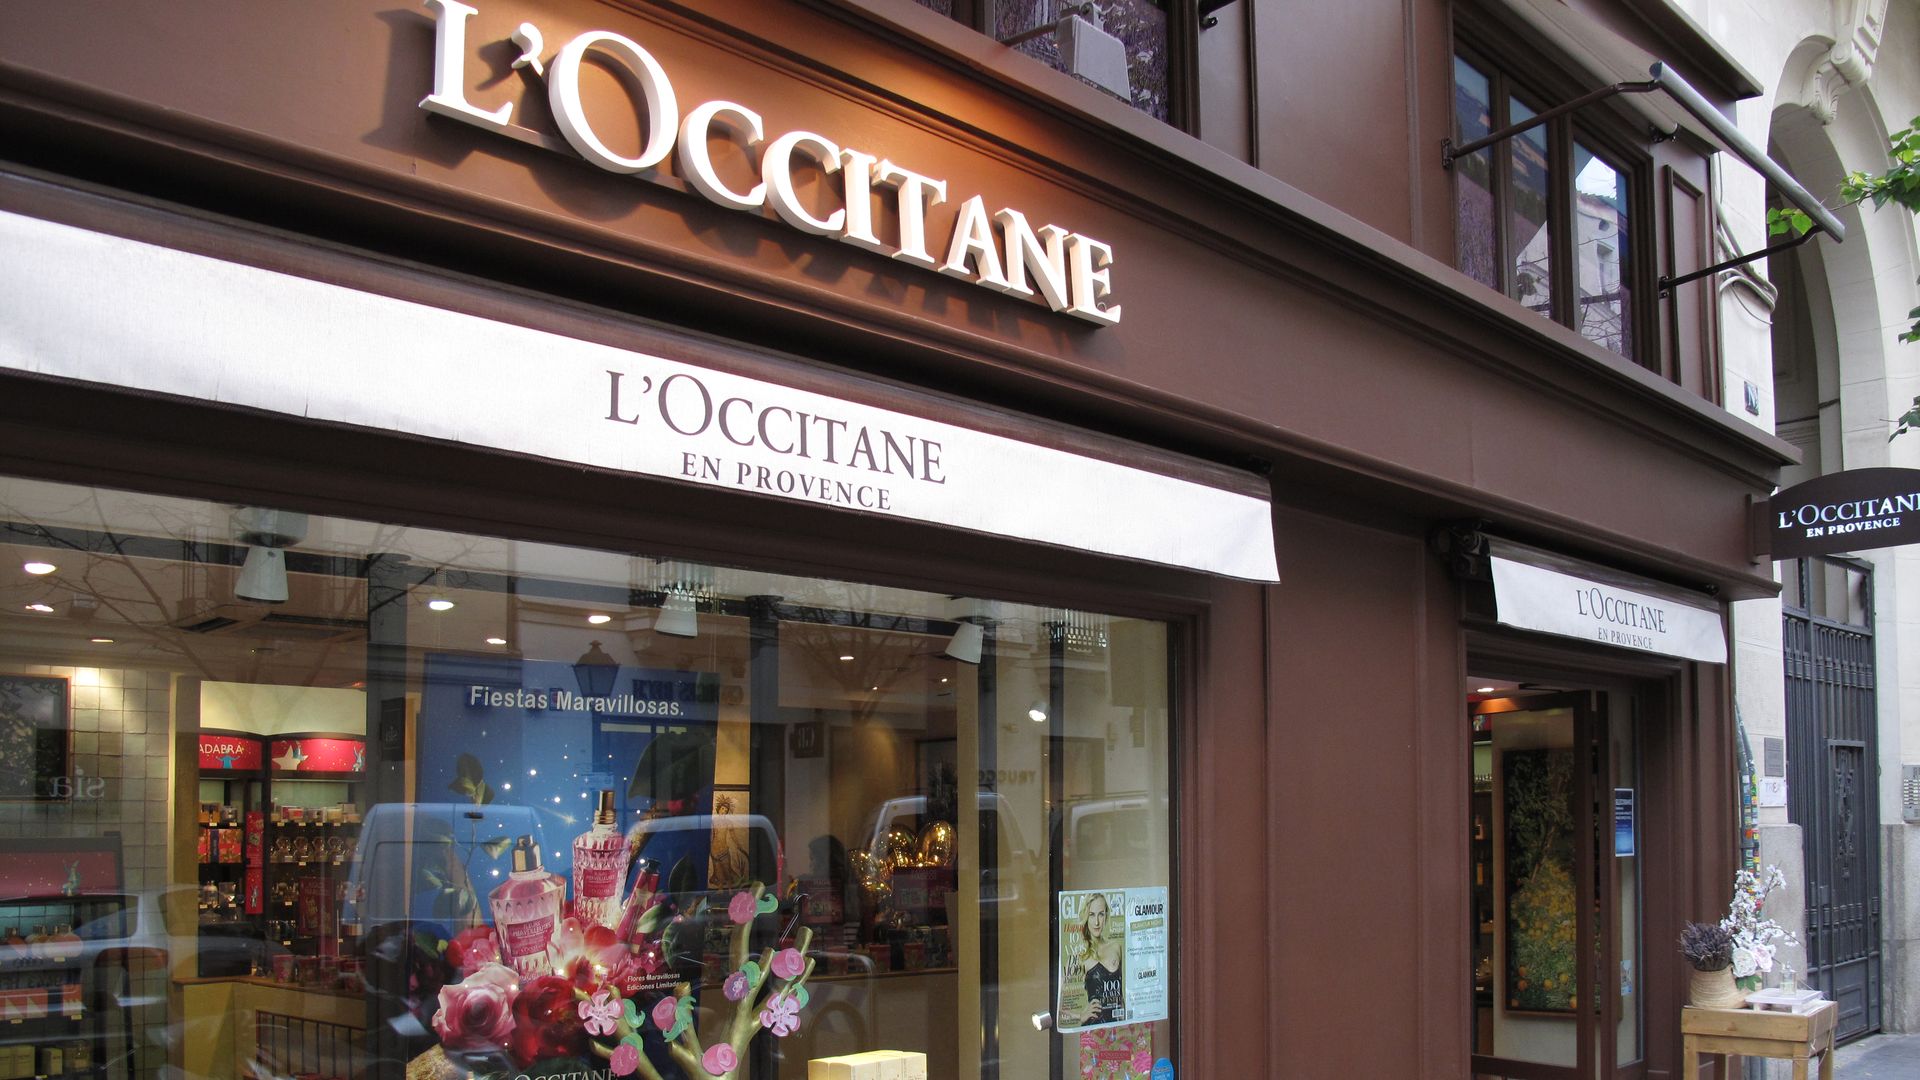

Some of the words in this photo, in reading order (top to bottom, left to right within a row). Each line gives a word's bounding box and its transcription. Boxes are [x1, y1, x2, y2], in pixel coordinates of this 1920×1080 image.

[419, 0, 1121, 326] L'OCCITANE
[605, 370, 946, 484] L'OCCITANE
[681, 452, 722, 480] EN
[737, 462, 891, 510] PROVENCE
[1806, 527, 1824, 537] EN
[1828, 517, 1901, 535] PROVENCE
[1576, 588, 1667, 633] L'OCCITANE
[1598, 627, 1608, 640] EN
[1611, 630, 1653, 649] PROVENCE
[471, 685, 548, 709] Fiestas
[556, 691, 685, 716] Maravillosas.
[1135, 904, 1163, 916] GLAMOUR
[627, 975, 646, 983] Flores
[646, 973, 680, 981] Maravillosas
[1103, 980, 1120, 991] 100
[1138, 970, 1157, 980] GLAMOUR
[626, 983, 655, 991] Ediciones
